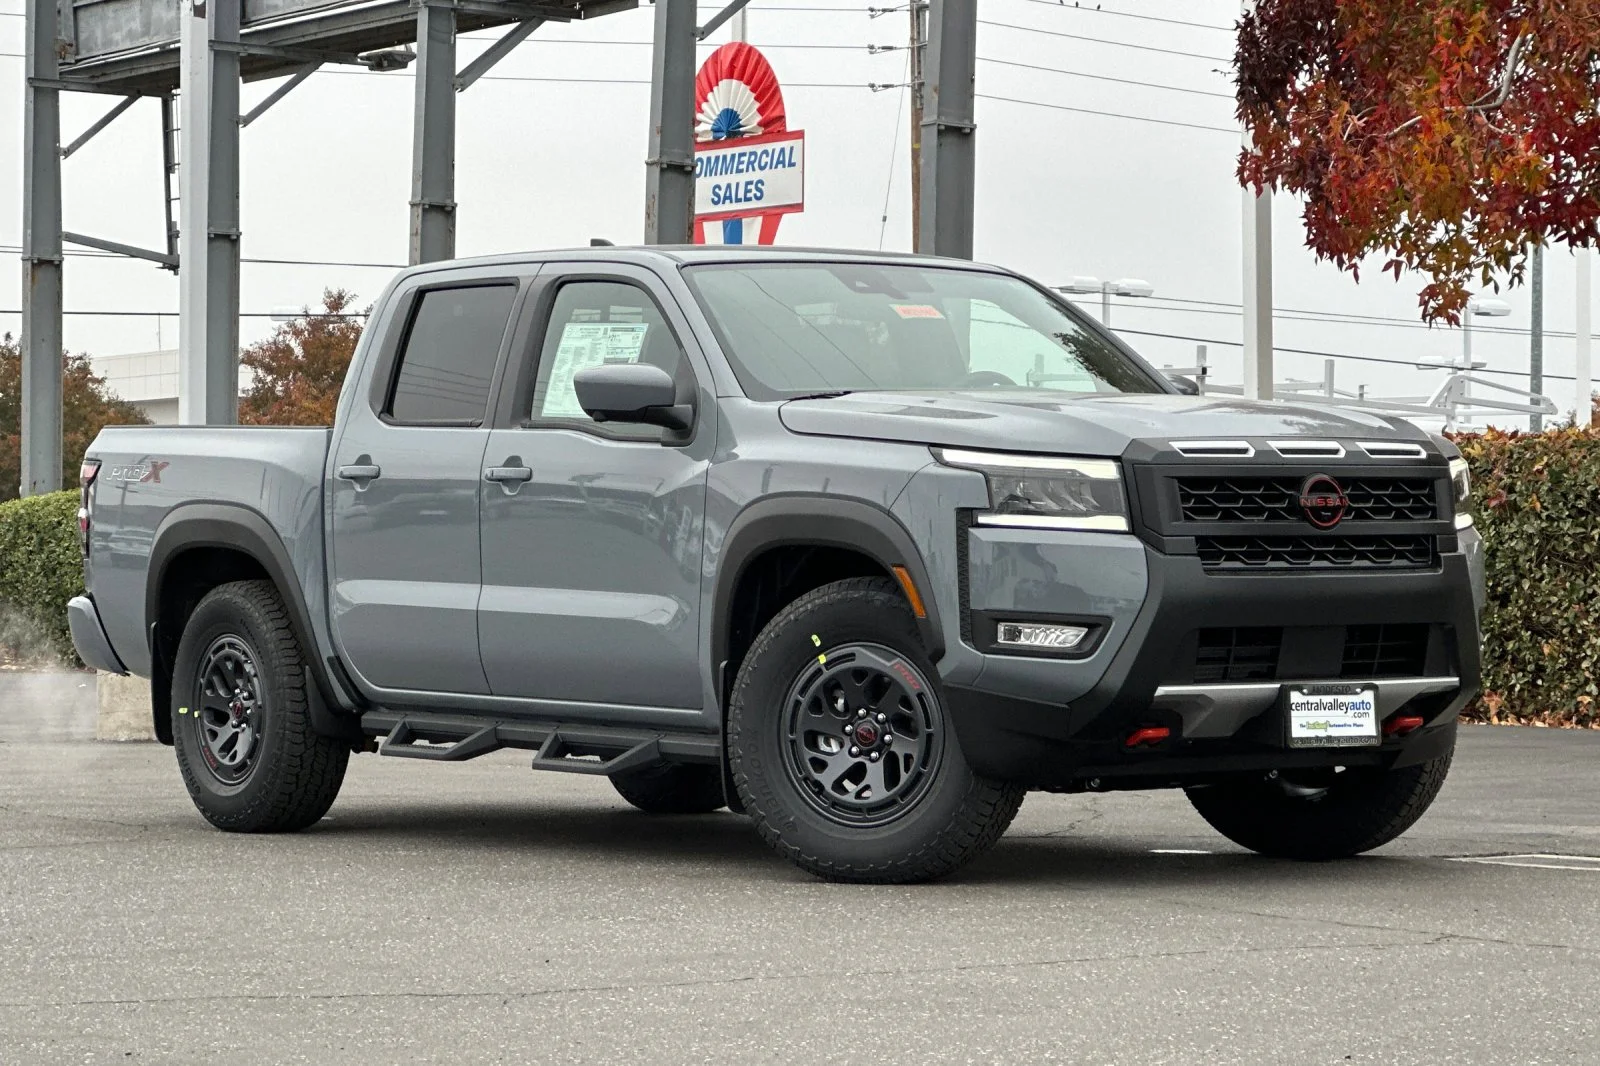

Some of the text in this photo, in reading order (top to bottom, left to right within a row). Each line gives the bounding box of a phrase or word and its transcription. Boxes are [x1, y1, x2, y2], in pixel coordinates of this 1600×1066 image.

[695, 146, 797, 178] OMMERCIAL
[711, 179, 765, 206] SALES
[1301, 498, 1348, 507] NISSAN
[1312, 685, 1352, 694] MODESTO
[1291, 698, 1372, 714] centralvalleyauto
